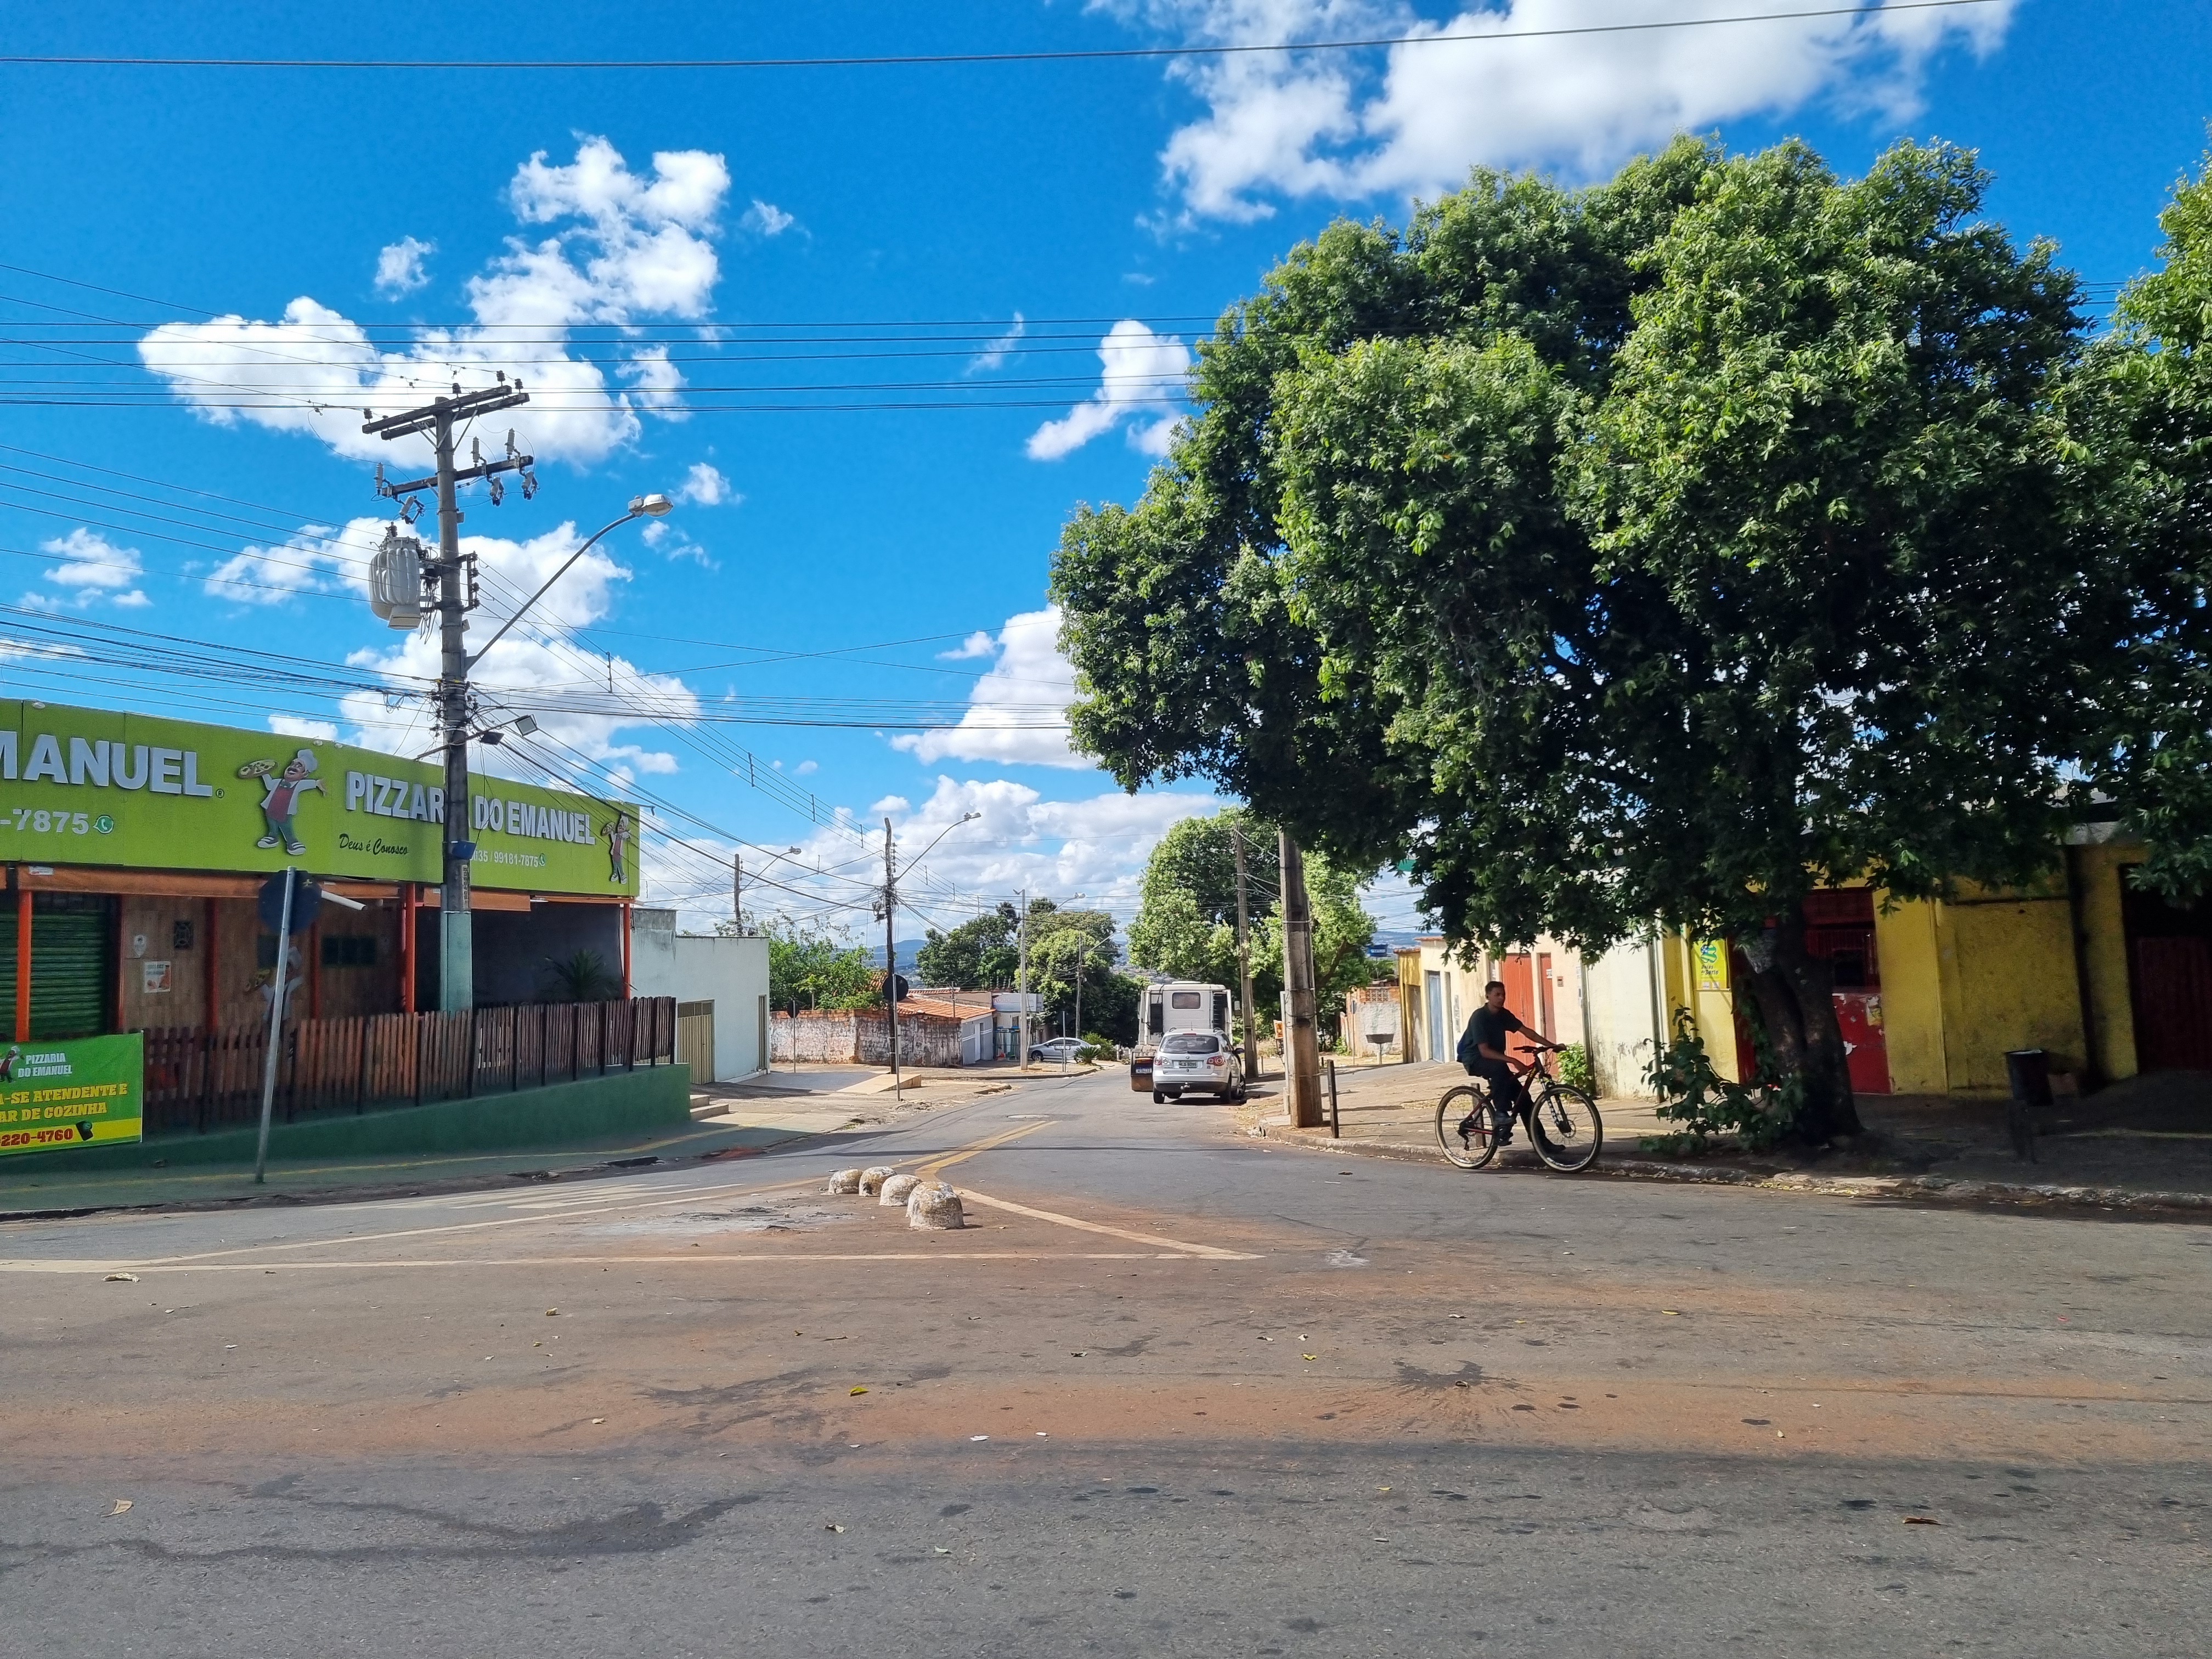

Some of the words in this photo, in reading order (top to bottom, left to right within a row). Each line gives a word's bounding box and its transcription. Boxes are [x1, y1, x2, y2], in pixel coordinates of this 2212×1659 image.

[346, 771, 470, 823] PIZZAR
[475, 795, 504, 831] DO
[506, 800, 595, 845] EMANUEL
[339, 833, 363, 851] Deus
[373, 838, 409, 855] Conosco
[494, 851, 538, 867] 99181-7875
[26, 1052, 66, 1065] PIZZARIA
[18, 1068, 31, 1078] DO
[33, 1064, 72, 1076] EMANUEL
[33, 1084, 117, 1103] ATENDENTE
[119, 1083, 128, 1095] E
[21, 1108, 41, 1121] DE
[44, 1102, 107, 1119] COZINHA
[1, 1128, 74, 1147] 220-4760
